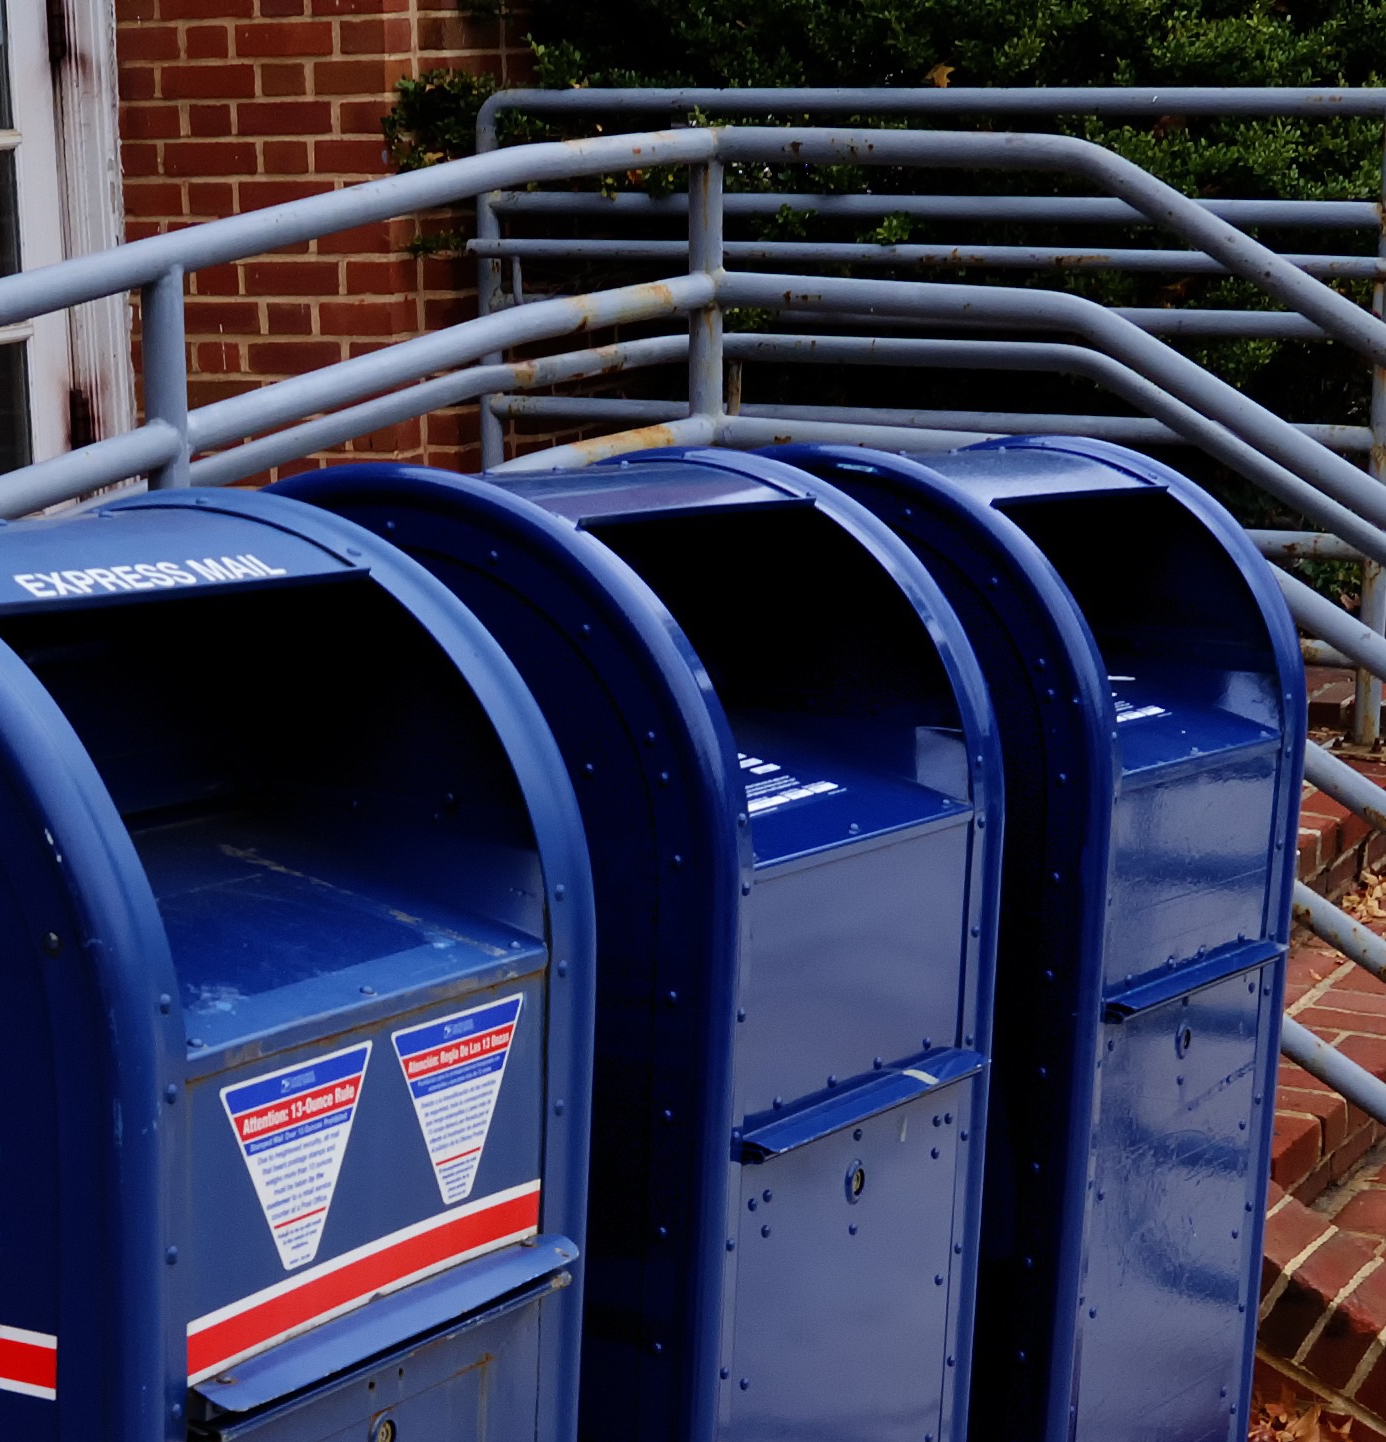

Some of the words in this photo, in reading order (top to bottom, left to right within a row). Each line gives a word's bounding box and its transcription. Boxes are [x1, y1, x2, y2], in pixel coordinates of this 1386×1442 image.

[13, 562, 197, 598] EXPRESS
[185, 554, 287, 582] MAIL
[482, 1037, 490, 1050] 13
[243, 1107, 289, 1136] Attention:
[291, 1092, 333, 1119] 13-Ounce
[335, 1084, 355, 1104] Rule
